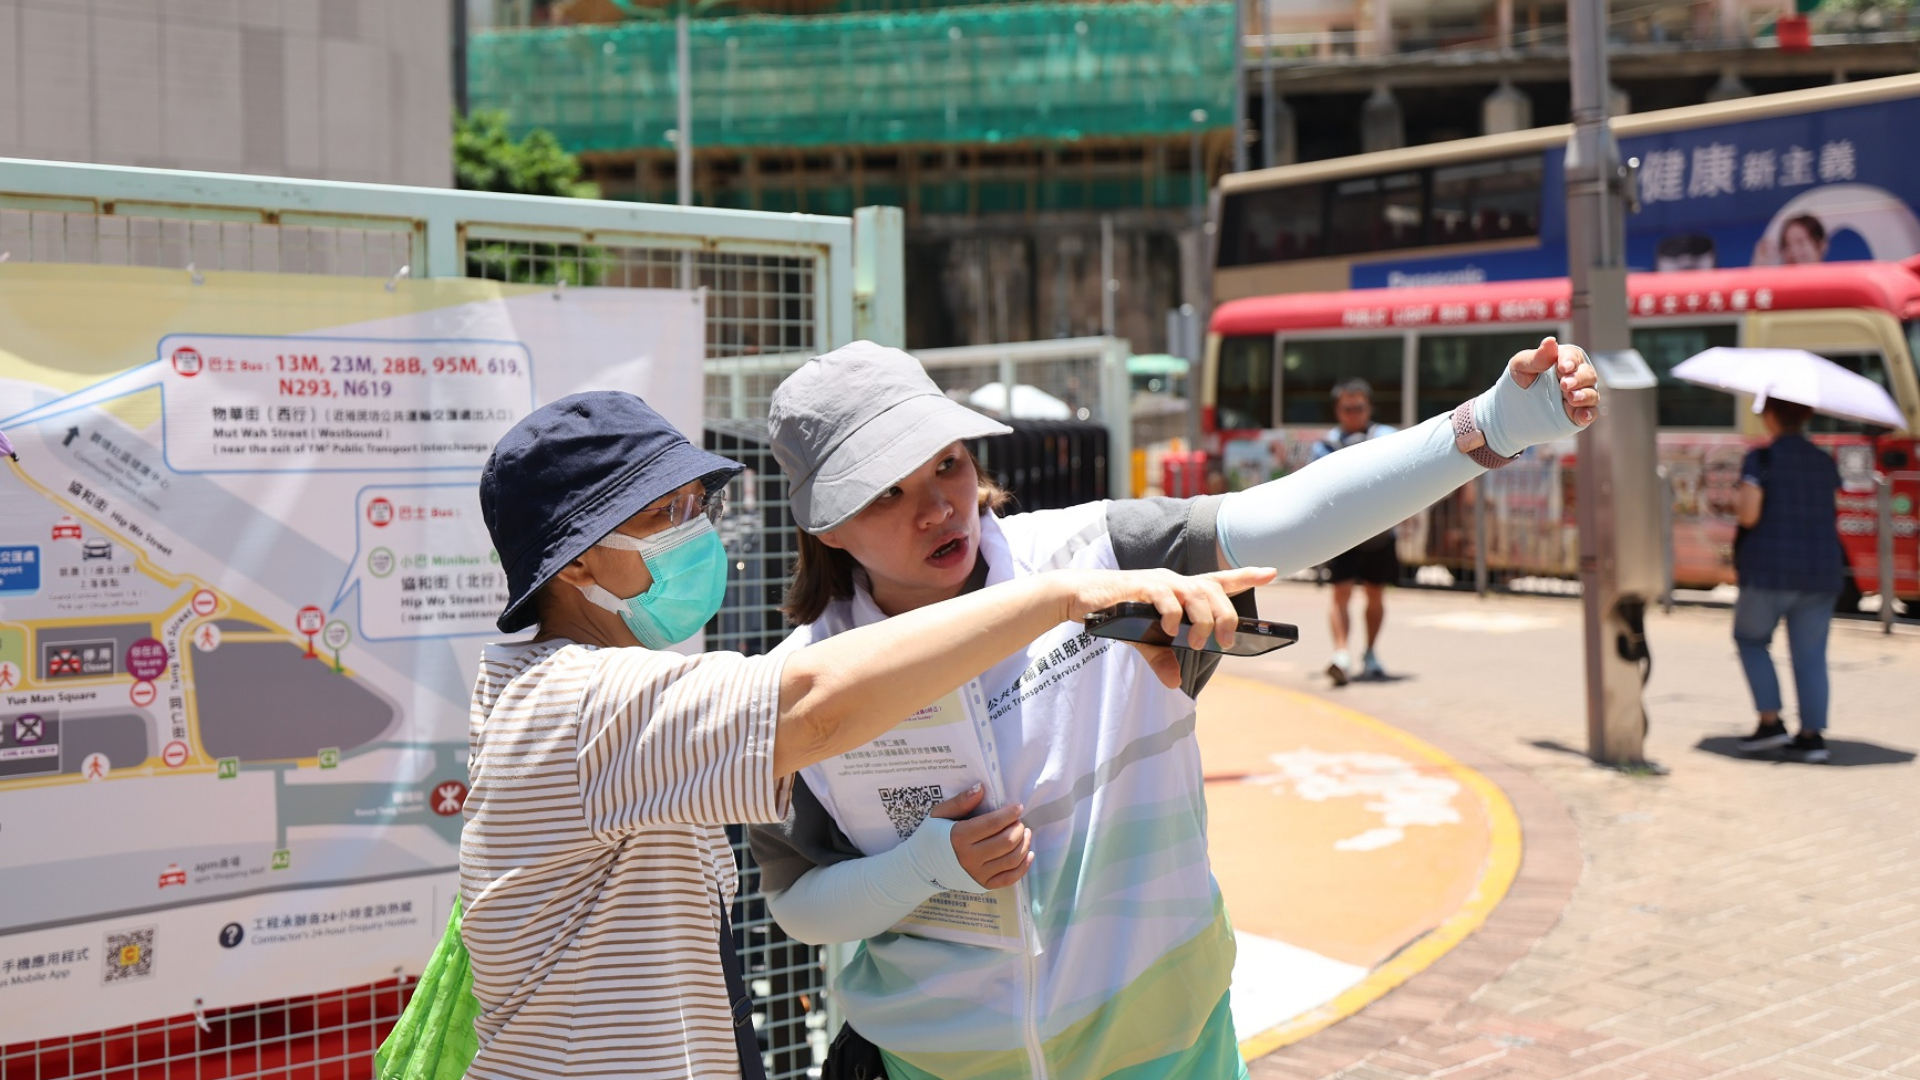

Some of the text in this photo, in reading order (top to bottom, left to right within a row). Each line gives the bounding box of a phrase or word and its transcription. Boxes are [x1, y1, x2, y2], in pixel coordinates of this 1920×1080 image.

[1640, 140, 1855, 203] 健康新主義
[208, 358, 236, 372] 巴士
[275, 355, 324, 374] 13M,
[330, 356, 377, 374] 23M,
[382, 357, 428, 375] 28B,
[432, 357, 482, 375] 95M,
[487, 358, 522, 376] 619,
[279, 379, 393, 398] N293, N619
[213, 428, 237, 438] Mut
[241, 428, 267, 438] Wah
[271, 428, 308, 438] Street
[249, 444, 267, 453] the
[270, 444, 290, 453] exit
[294, 444, 305, 453] of
[332, 443, 363, 453] Public
[367, 443, 418, 455] Transport
[399, 507, 425, 519] 巴士
[110, 511, 127, 527] Hip
[128, 522, 143, 537] Wo
[145, 532, 172, 556] Street
[401, 555, 426, 568] 小巴
[401, 597, 421, 609] Hip
[427, 596, 445, 605] Wo
[449, 594, 484, 604] Street
[167, 608, 193, 636] Street
[437, 612, 455, 620] the
[459, 610, 502, 619] entranc
[83, 662, 110, 672] Closed
[132, 659, 148, 667] You
[138, 668, 157, 676] here
[987, 631, 1097, 712] 公共運輸資訊服務
[7, 691, 97, 706] Yue Man Square
[989, 704, 1012, 721] Public
[1012, 679, 1051, 706] Transport
[1052, 662, 1081, 683] Service
[219, 761, 236, 776] A1
[273, 853, 289, 867] A2
[384, 917, 417, 927] Hotline
[10, 973, 46, 985] Mobile
[49, 969, 70, 979] App
